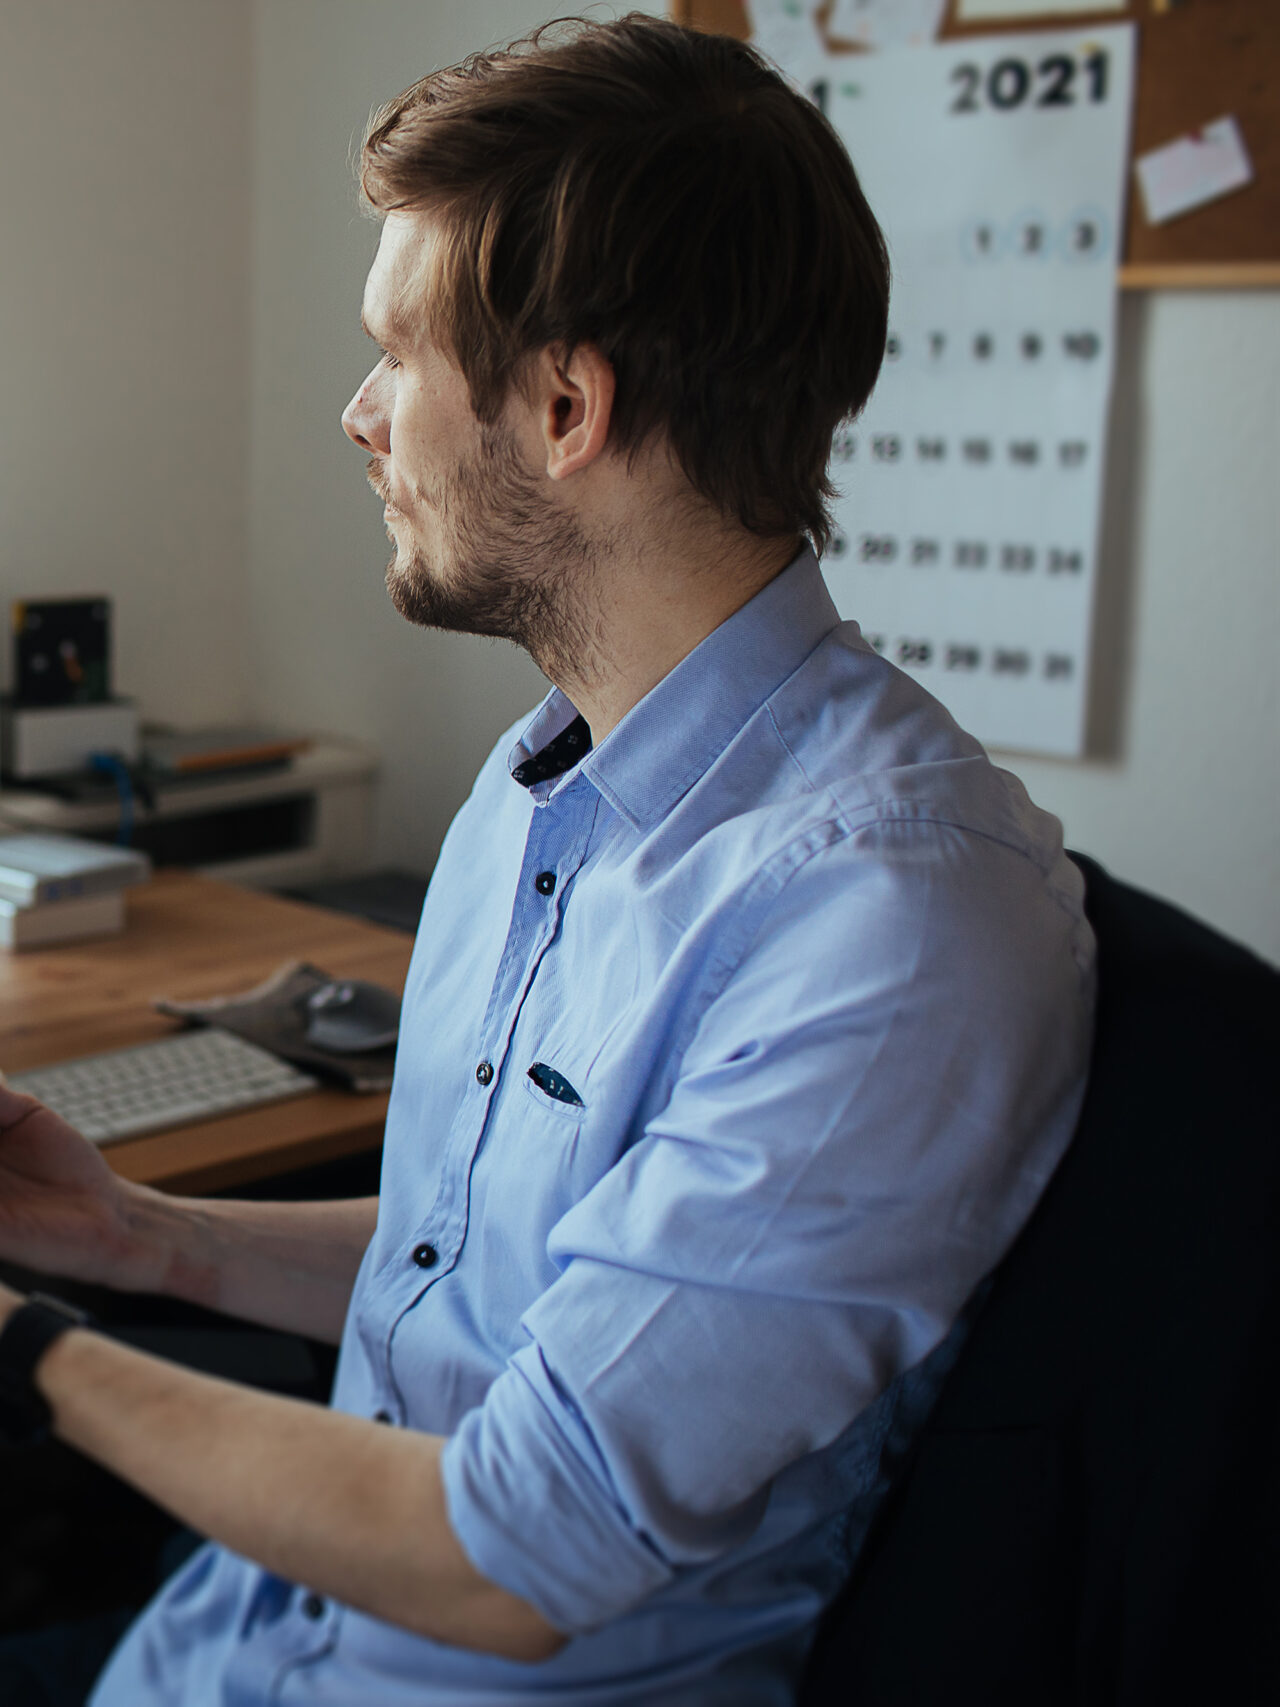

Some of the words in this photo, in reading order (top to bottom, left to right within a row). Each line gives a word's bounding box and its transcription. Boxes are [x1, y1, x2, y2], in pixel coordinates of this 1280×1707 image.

[949, 47, 1111, 115] 2021
[976, 225, 992, 253] 1
[1024, 224, 1044, 254] 2
[1075, 222, 1096, 252] 3
[928, 331, 947, 361] 7
[973, 332, 994, 361] 8
[1021, 332, 1043, 361] 9
[1061, 330, 1101, 363] 10
[872, 435, 901, 463] 13
[917, 436, 947, 463] 14
[961, 437, 993, 467] 15
[1009, 439, 1040, 468] 16
[1057, 440, 1089, 470] 17
[860, 535, 897, 563] 20
[910, 537, 941, 567] 21
[953, 540, 989, 571] 22
[1000, 543, 1037, 574] 23
[1046, 547, 1083, 577] 24
[898, 639, 933, 671] 28
